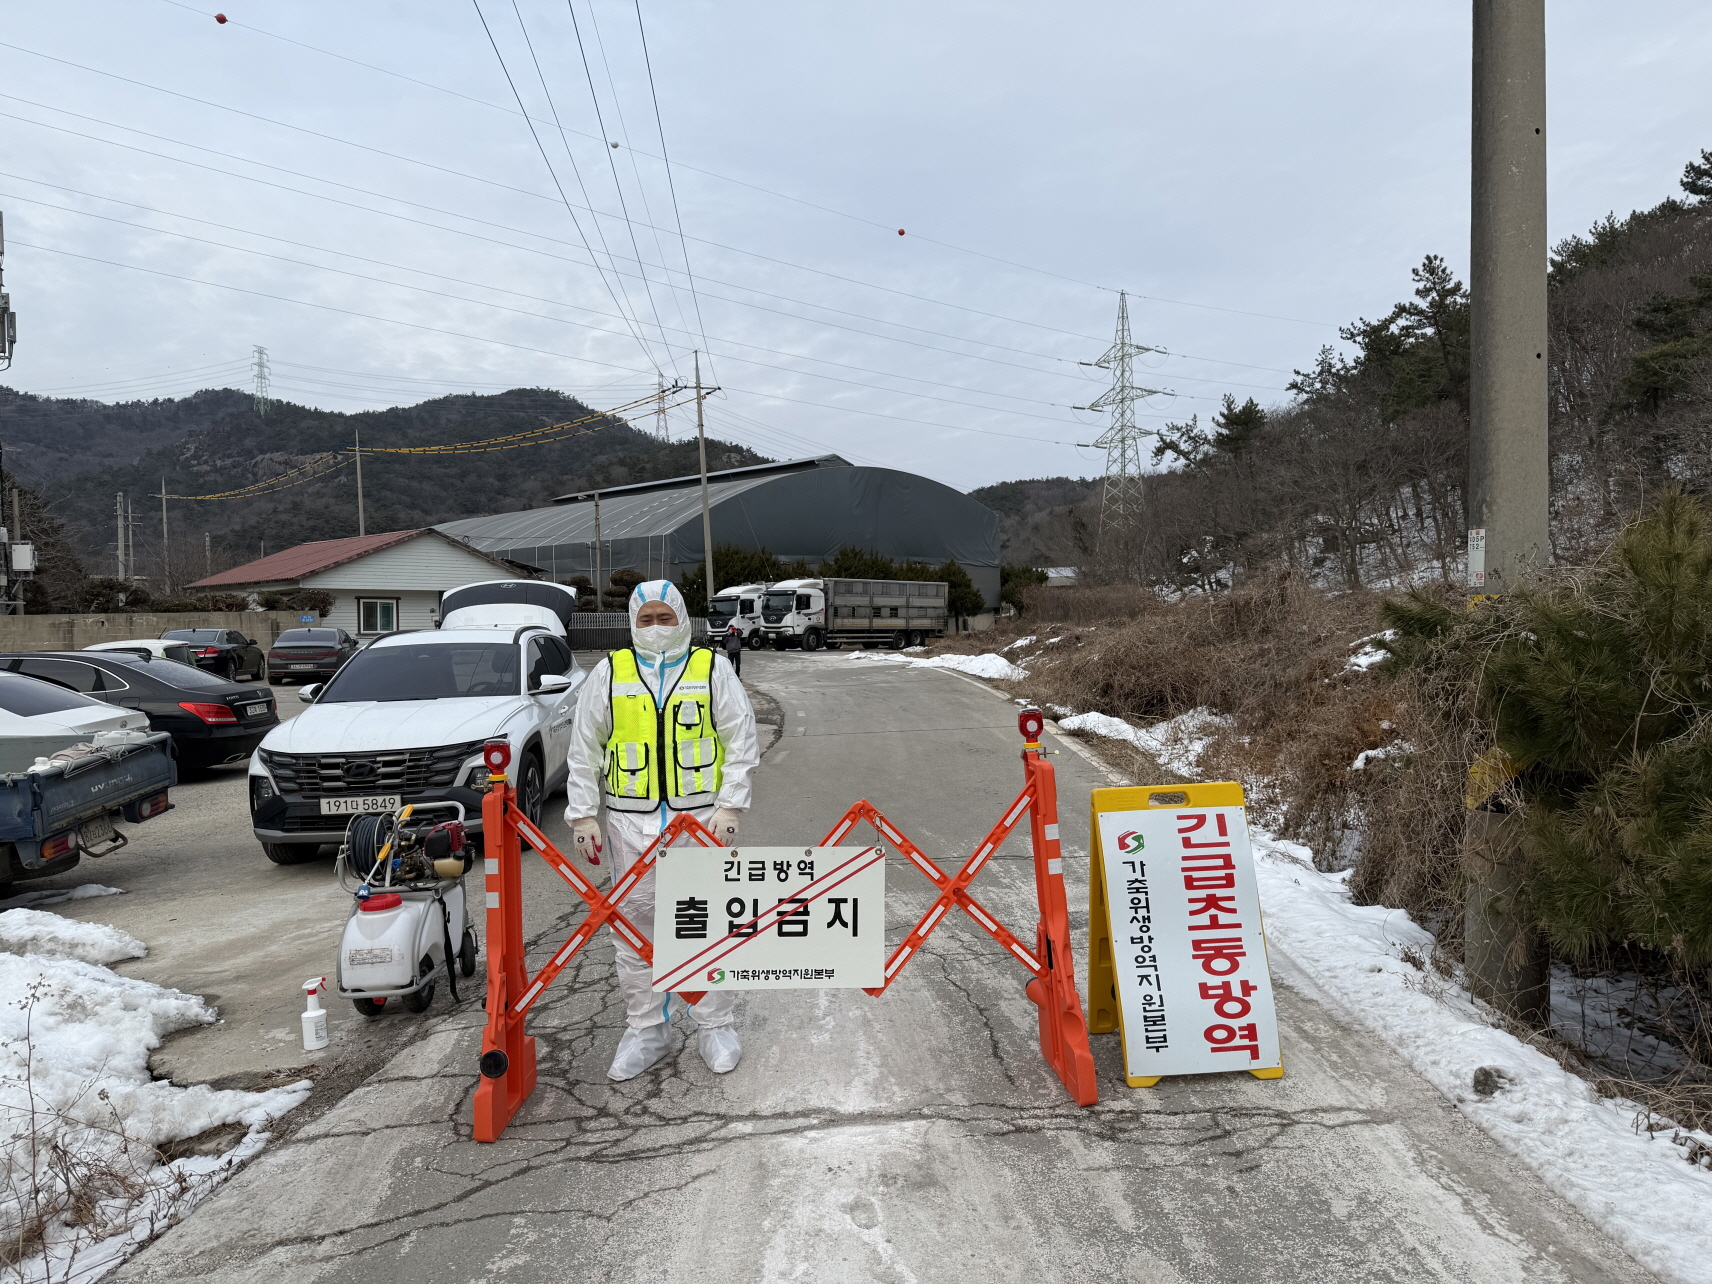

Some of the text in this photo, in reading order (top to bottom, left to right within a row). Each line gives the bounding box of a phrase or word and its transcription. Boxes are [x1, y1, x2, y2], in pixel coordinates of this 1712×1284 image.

[325, 797, 396, 812] 191다 5849
[724, 860, 815, 882] 긴급방역
[674, 896, 859, 939] 출입금지
[1177, 813, 1260, 1061] 긴급초동방역
[1121, 860, 1169, 1054] 가축위생방역지원본부
[729, 967, 835, 981] 가축위생방역지원본부
